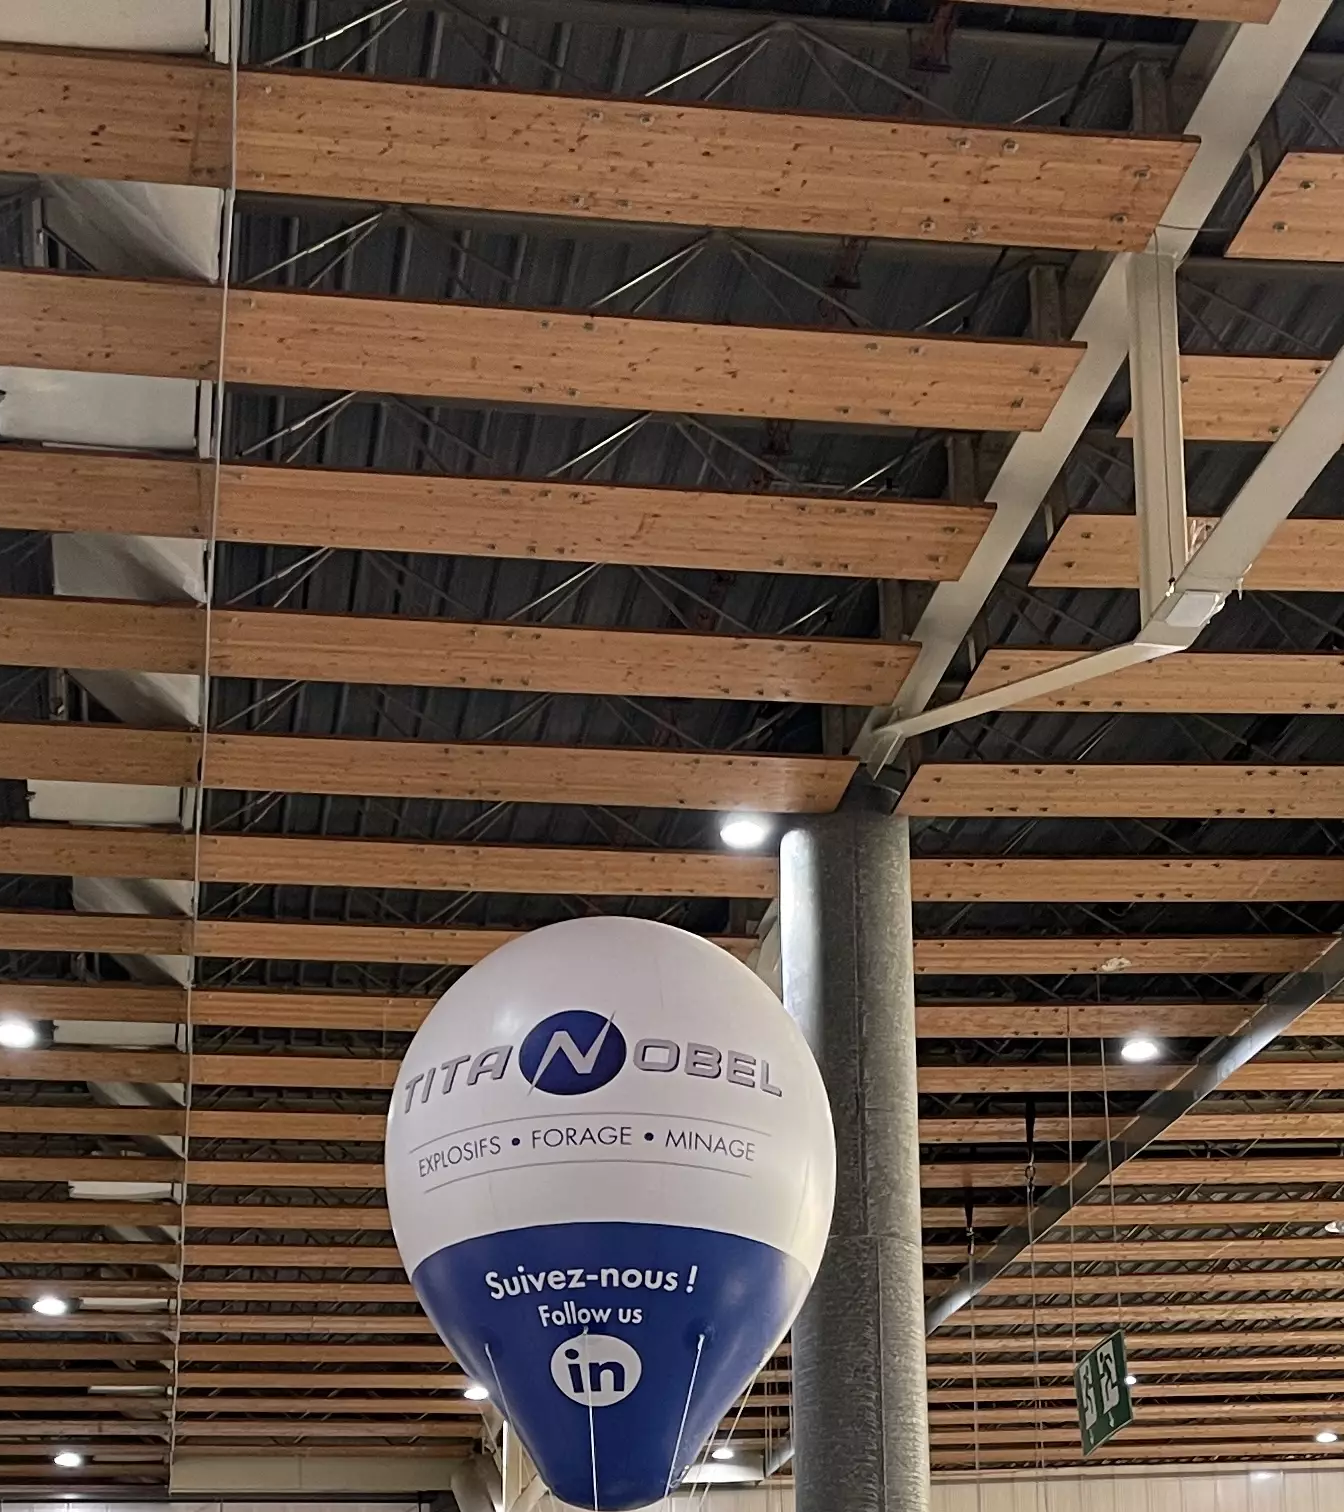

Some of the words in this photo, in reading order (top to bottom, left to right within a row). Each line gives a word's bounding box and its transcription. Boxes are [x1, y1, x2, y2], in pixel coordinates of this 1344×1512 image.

[401, 1010, 783, 1114] TITANOBEL
[418, 1136, 501, 1178] EXPLOSIFS
[531, 1126, 633, 1149] FORAGE
[665, 1131, 756, 1162] MINAGE
[485, 1265, 679, 1300] Suivez-nous
[538, 1303, 611, 1328] Follow
[618, 1306, 643, 1325] us
[564, 1350, 625, 1395] in
